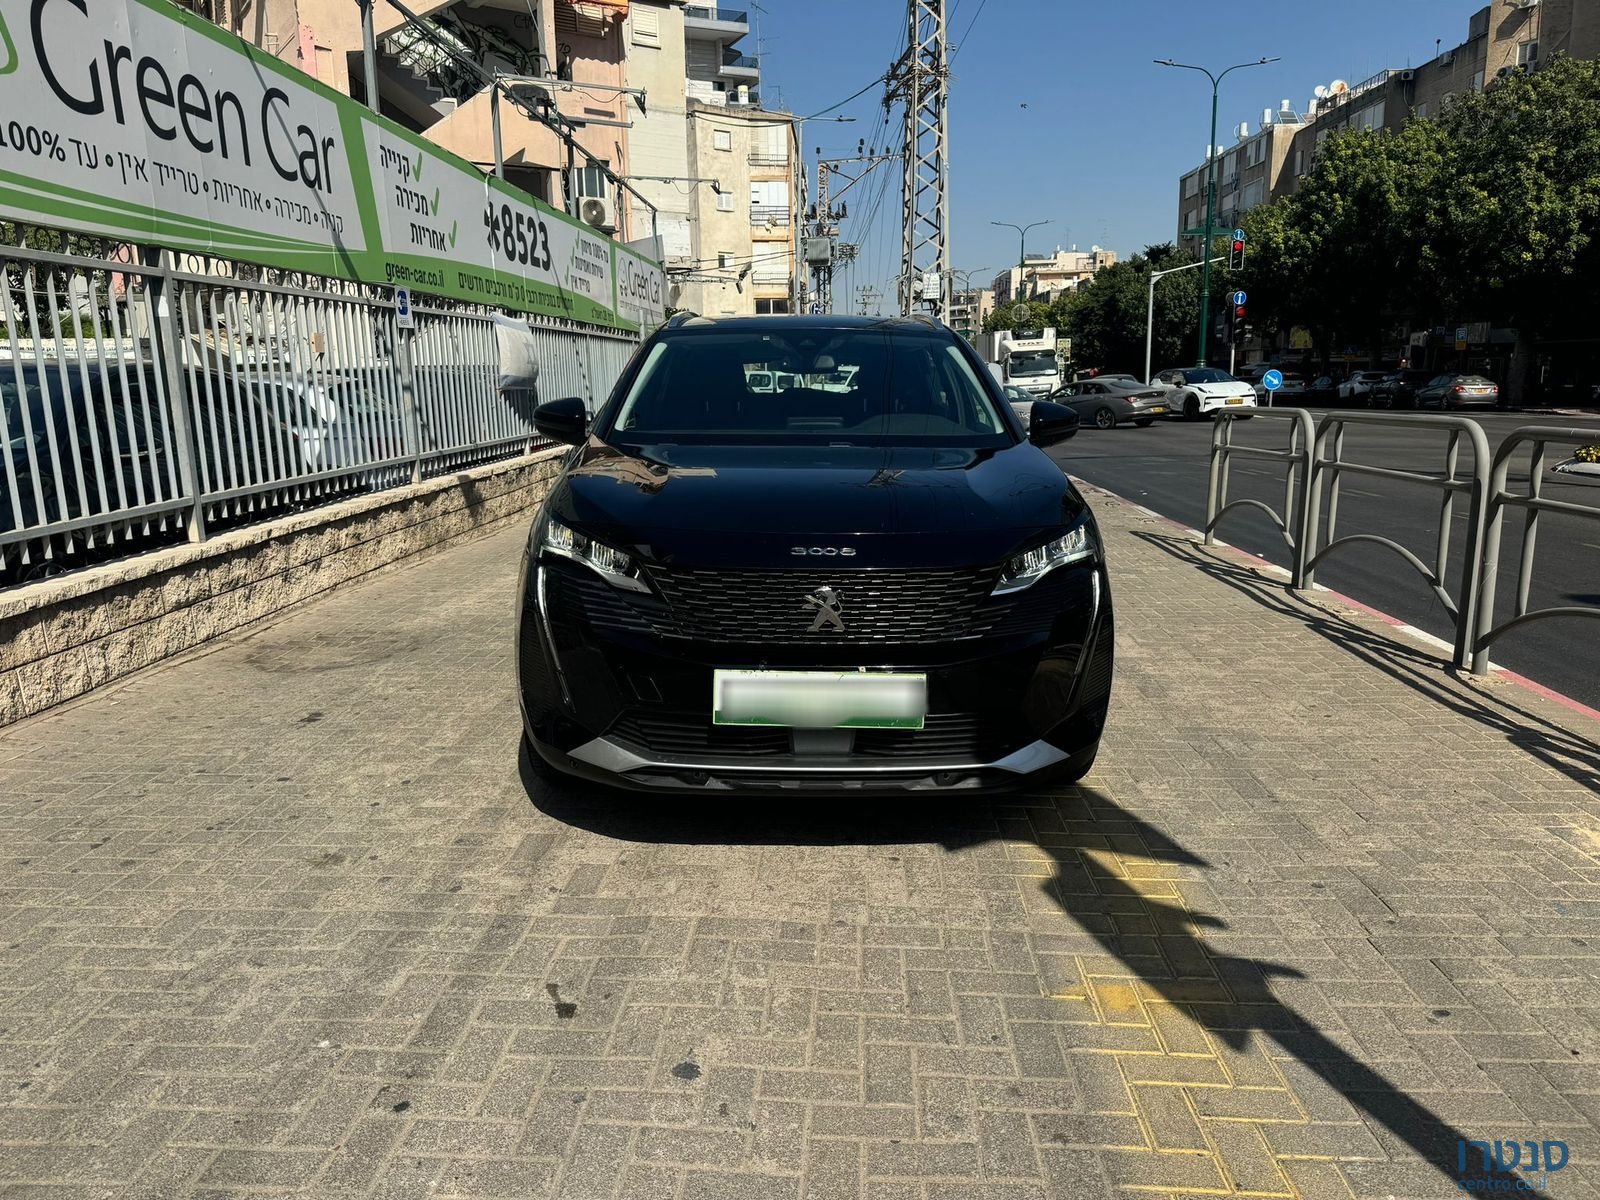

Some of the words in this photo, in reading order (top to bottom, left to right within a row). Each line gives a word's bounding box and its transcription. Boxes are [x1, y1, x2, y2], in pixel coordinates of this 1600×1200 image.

[30, 0, 251, 167] Green
[261, 88, 335, 194] Car
[68, 138, 98, 169] עד
[118, 152, 148, 185] אין
[380, 145, 410, 183] קנייה
[153, 161, 198, 195] טרייד
[212, 179, 263, 212] אחריות
[274, 197, 311, 225] מכירה
[395, 185, 429, 216] מכירה
[321, 211, 344, 238] קניה
[410, 222, 447, 252] אחריות
[385, 262, 445, 288] green-car.co.il
[458, 272, 485, 294] חדשים
[628, 260, 648, 300] Green
[790, 547, 857, 556] 3008
